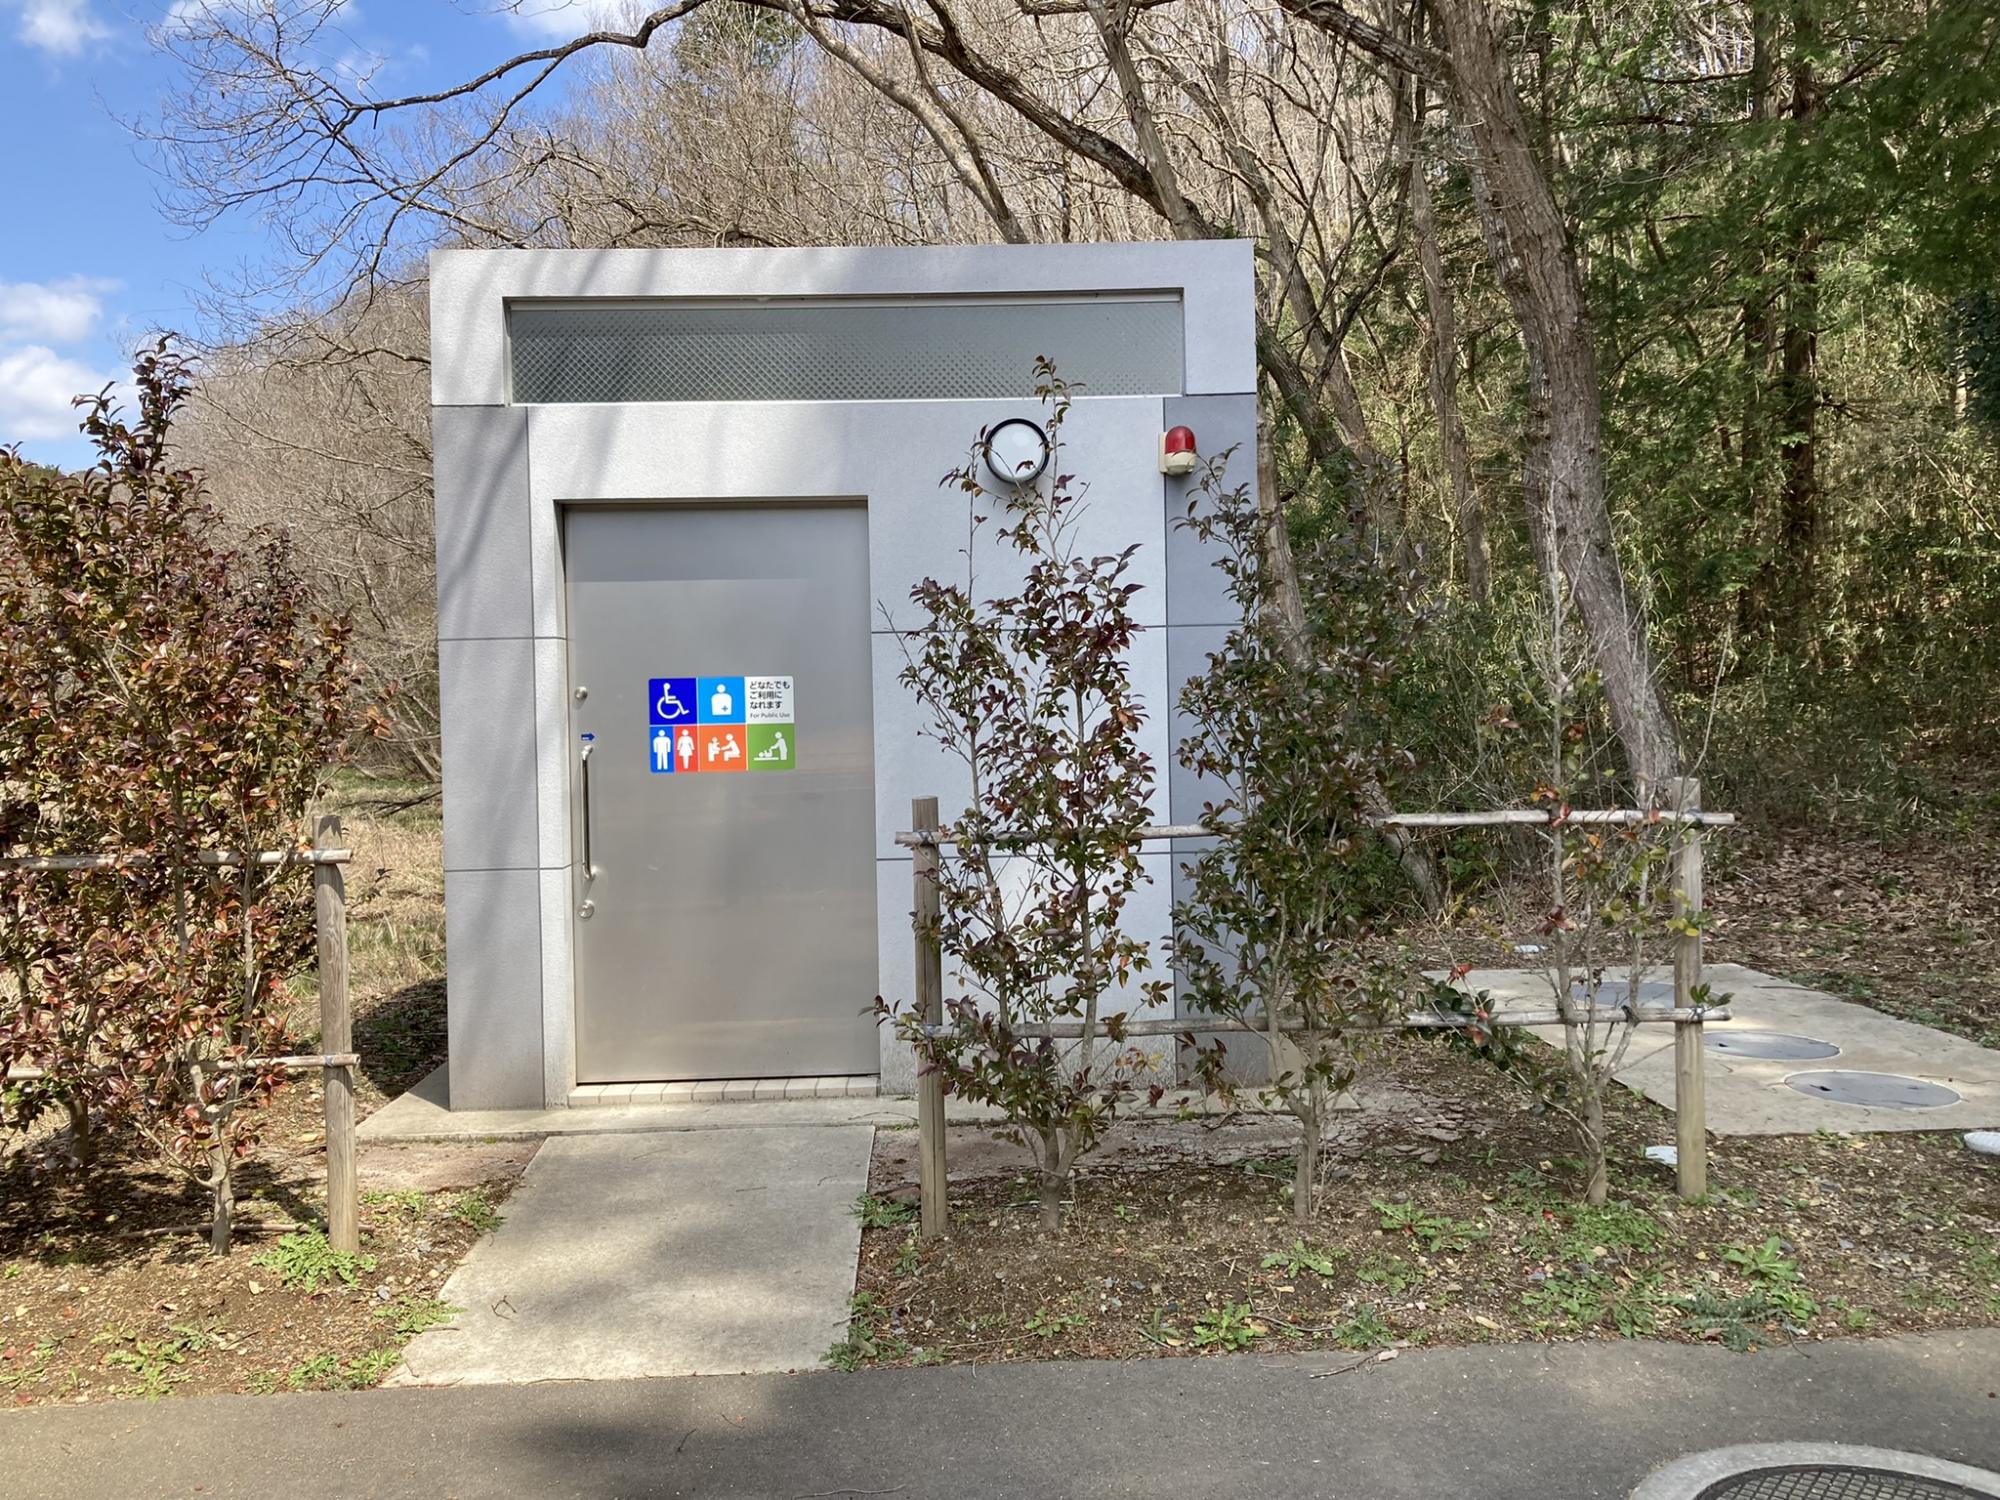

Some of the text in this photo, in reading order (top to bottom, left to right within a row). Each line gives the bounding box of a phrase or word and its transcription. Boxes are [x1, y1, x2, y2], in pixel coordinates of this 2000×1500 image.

[750, 681, 790, 690] どなたでも
[750, 691, 782, 700] ご利用に
[750, 701, 782, 710] なれます
